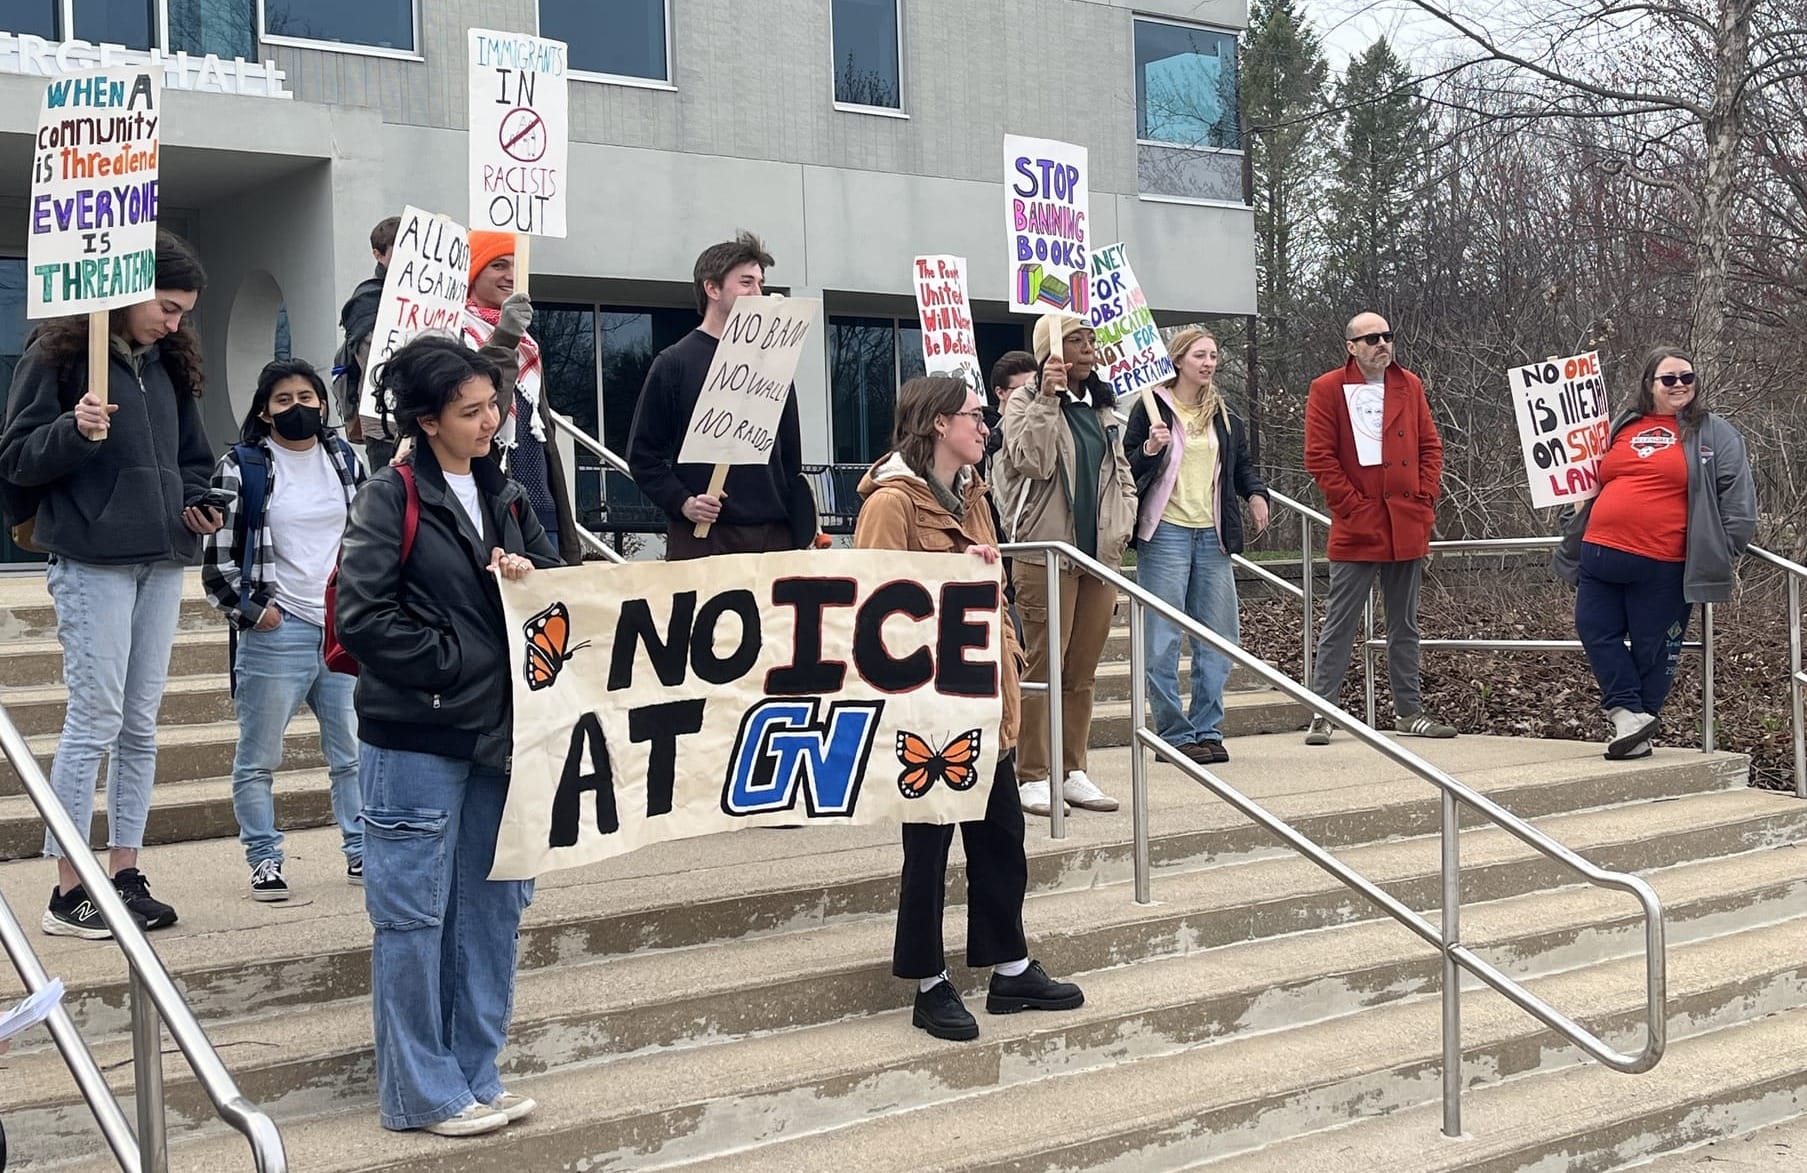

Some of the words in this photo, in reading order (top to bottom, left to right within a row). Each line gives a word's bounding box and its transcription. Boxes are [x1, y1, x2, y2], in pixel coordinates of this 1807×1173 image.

[151, 48, 294, 99] HALL
[476, 36, 564, 76] IMMIGRANTS
[47, 76, 125, 109] WHEN
[127, 74, 153, 111] A
[496, 68, 536, 107] IN
[484, 164, 556, 197] RACISTS
[1013, 156, 1079, 204] STOP
[33, 180, 159, 235] EVERYONE
[489, 195, 550, 235] OUT
[1013, 199, 1085, 243] BANNING
[82, 233, 111, 253] IS
[399, 216, 443, 263] ALL
[449, 237, 470, 272] OUT
[1017, 235, 1086, 270] BOOKS
[1091, 243, 1126, 278] NEY
[398, 261, 468, 304] AGAINST
[916, 259, 936, 280] The
[1091, 271, 1126, 300] OR
[722, 312, 762, 344] NO
[1091, 296, 1123, 328] OBS
[924, 334, 941, 357] Be
[1132, 324, 1158, 351] FOR
[708, 361, 750, 392] NO
[1109, 346, 1156, 381] MASS
[1522, 364, 1559, 388] NO
[694, 407, 733, 439] NO
[606, 588, 762, 693] NO
[763, 576, 1000, 698] ICE
[549, 698, 706, 848] AT
